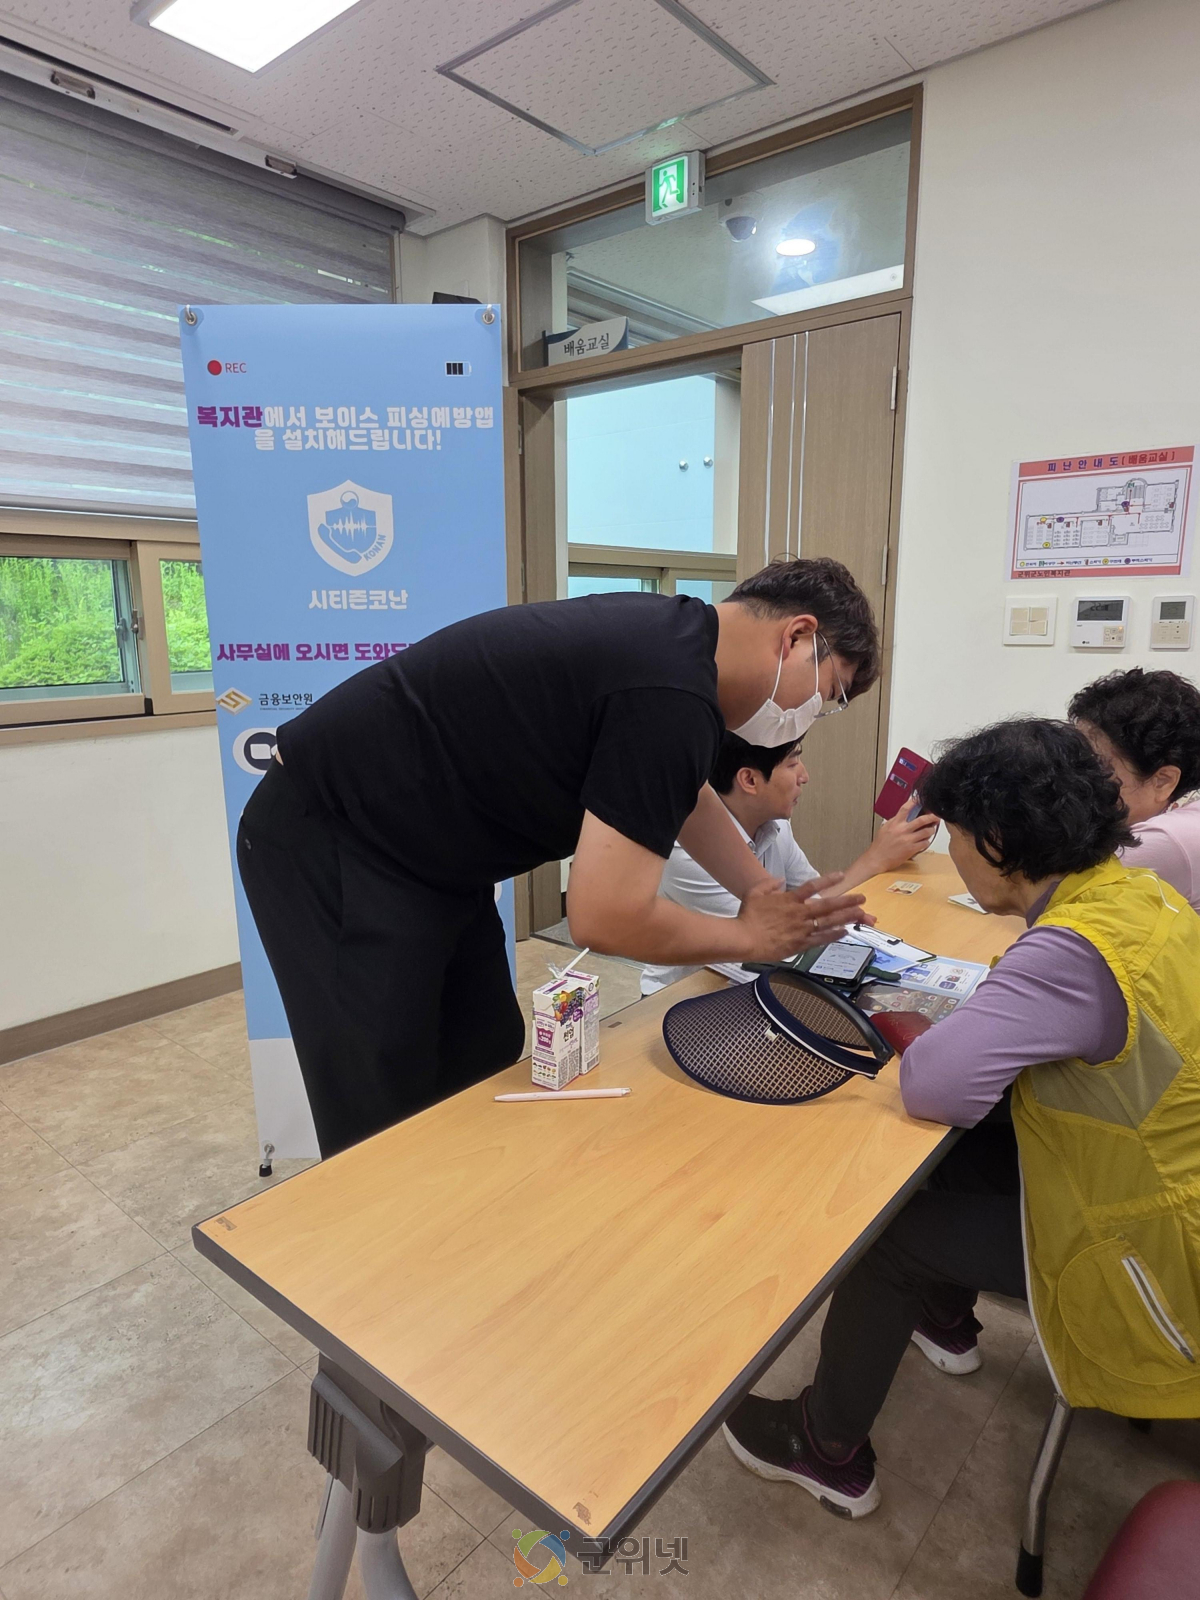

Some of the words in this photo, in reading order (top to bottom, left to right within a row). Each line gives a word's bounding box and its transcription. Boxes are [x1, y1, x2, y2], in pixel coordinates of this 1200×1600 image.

[563, 332, 610, 357] 배움교실
[225, 362, 247, 374] REC
[197, 405, 307, 428] 복지관에서
[315, 406, 380, 428] 보이스
[386, 406, 494, 429] 피싱예방앱
[254, 429, 275, 451] 을
[282, 429, 442, 451] 설치해드립니다!
[363, 533, 387, 562] KONAN
[308, 589, 409, 611] 시티즌코난
[216, 643, 291, 662] 사무실에
[295, 642, 350, 662] 오시면
[258, 692, 314, 706] 금융보안원
